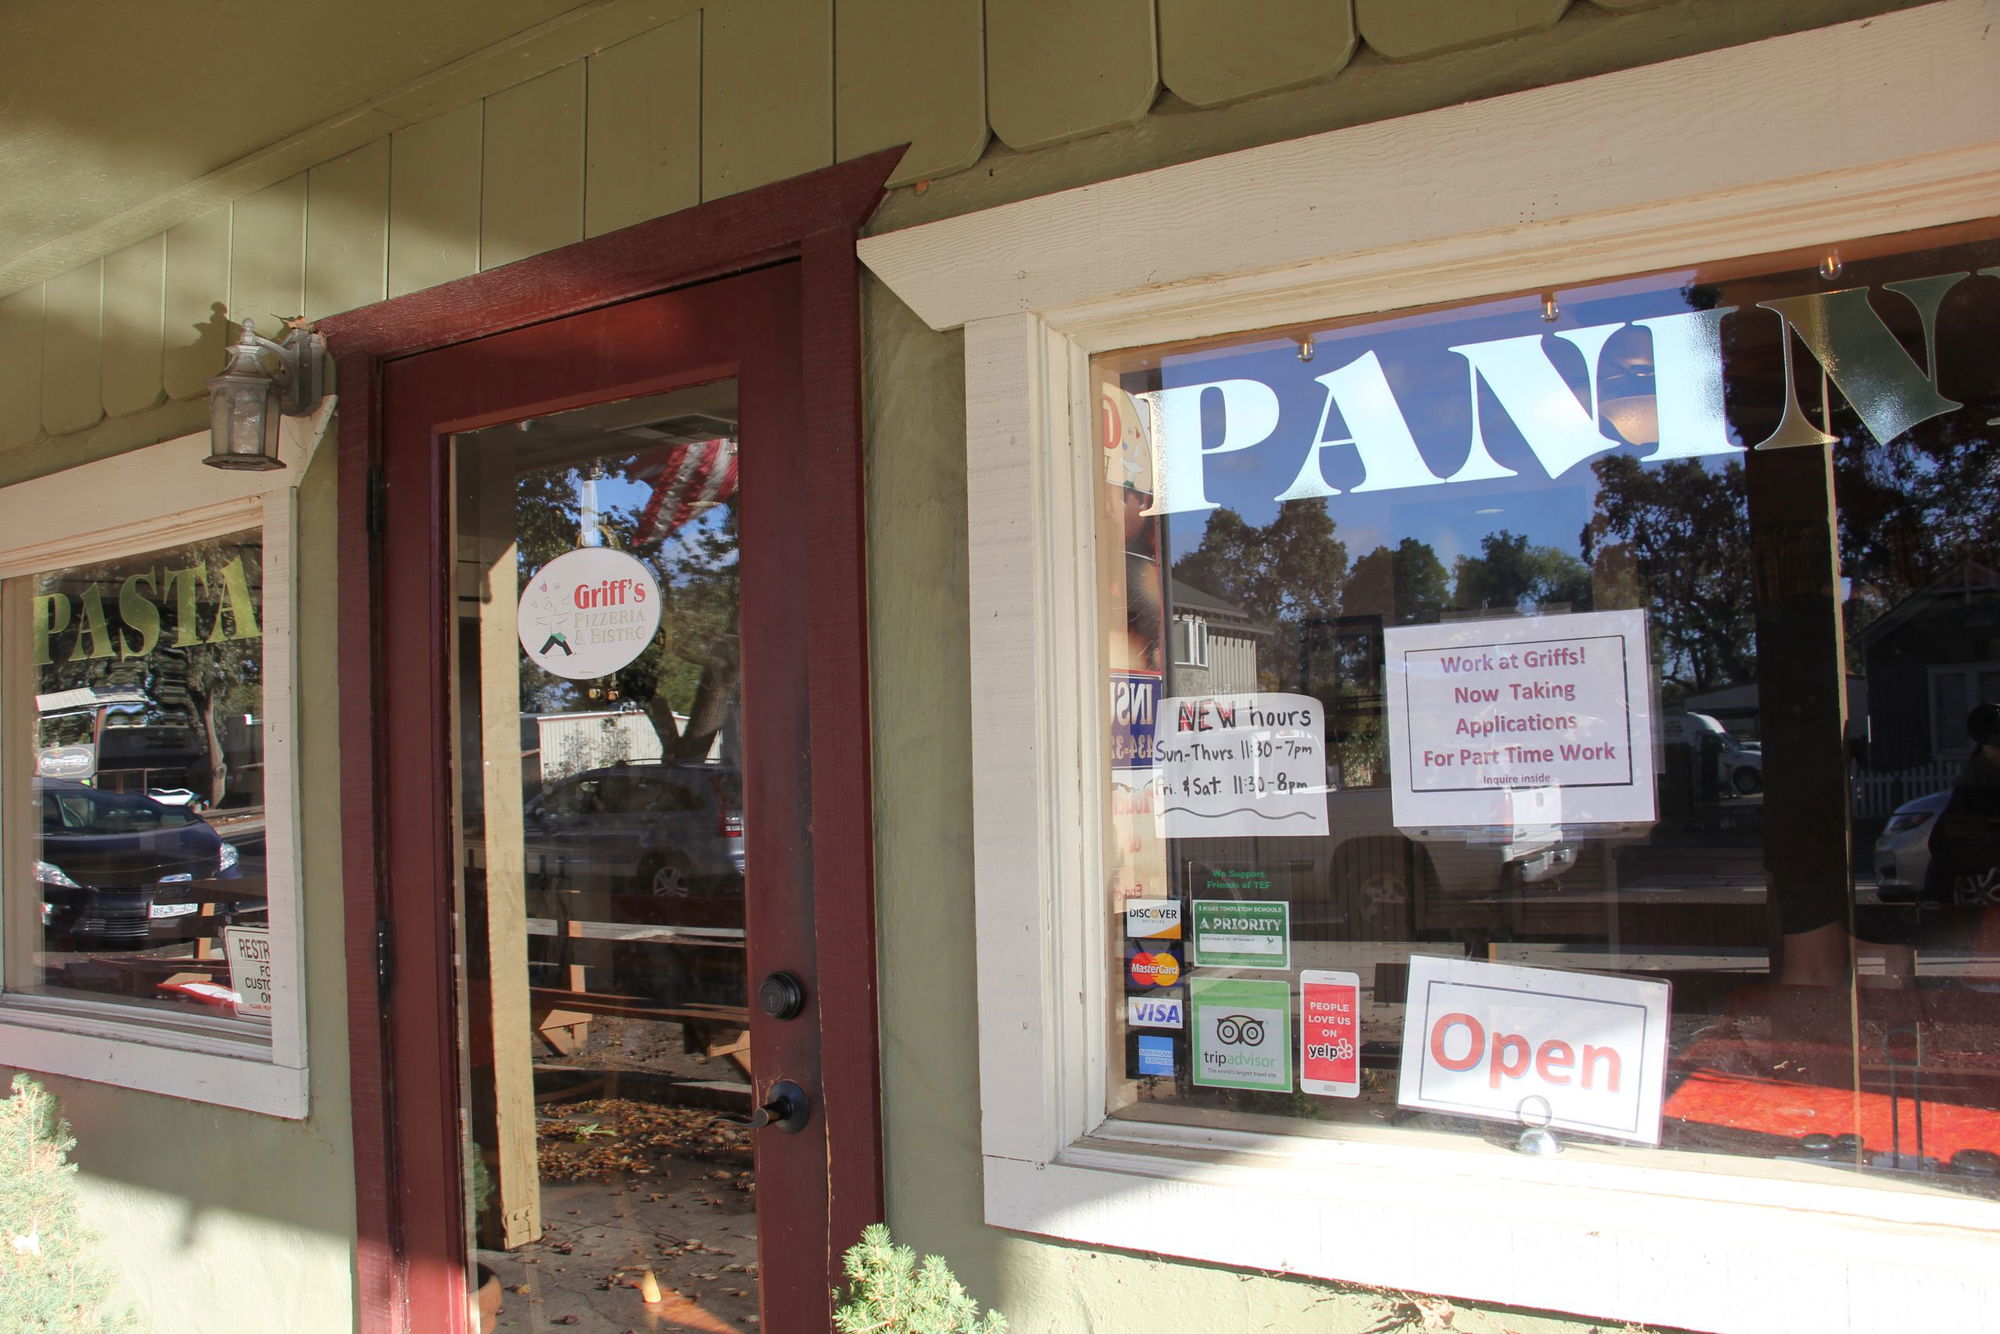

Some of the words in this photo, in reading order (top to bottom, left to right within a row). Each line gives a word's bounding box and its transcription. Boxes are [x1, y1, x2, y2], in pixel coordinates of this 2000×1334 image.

[574, 578, 646, 609] Griff's
[33, 555, 263, 666] PASTA
[574, 609, 645, 629] PIZZERIA
[591, 626, 645, 644] BISTRO
[1440, 653, 1493, 673] Work
[1498, 652, 1519, 669] at
[1523, 646, 1586, 668] Griffs!
[1454, 686, 1499, 704] Now
[1509, 681, 1576, 701] Taking
[1177, 699, 1236, 732] NEW
[1249, 702, 1312, 727] hours
[1455, 713, 1578, 738] Applications
[1423, 750, 1454, 767] For
[1460, 748, 1500, 766] Part
[1504, 746, 1554, 764] Time
[1559, 742, 1617, 761] Work
[1483, 774, 1519, 785] Inquire
[1229, 869, 1265, 879] Support
[1207, 881, 1239, 889] Friends
[1129, 908, 1177, 919] DISCOVER
[1199, 918, 1209, 929] A
[1213, 918, 1282, 931] PRIORITY
[1131, 964, 1178, 975] MasterCard
[1133, 1002, 1180, 1024] VISA
[1310, 1002, 1349, 1012] PEOPLE
[1308, 1015, 1335, 1025] LOVE
[1337, 1017, 1351, 1026] US
[1322, 1029, 1337, 1037] ON
[1204, 1051, 1275, 1067] tripadvisor
[1309, 1044, 1338, 1060] yelp
[1430, 1012, 1622, 1093] Open
